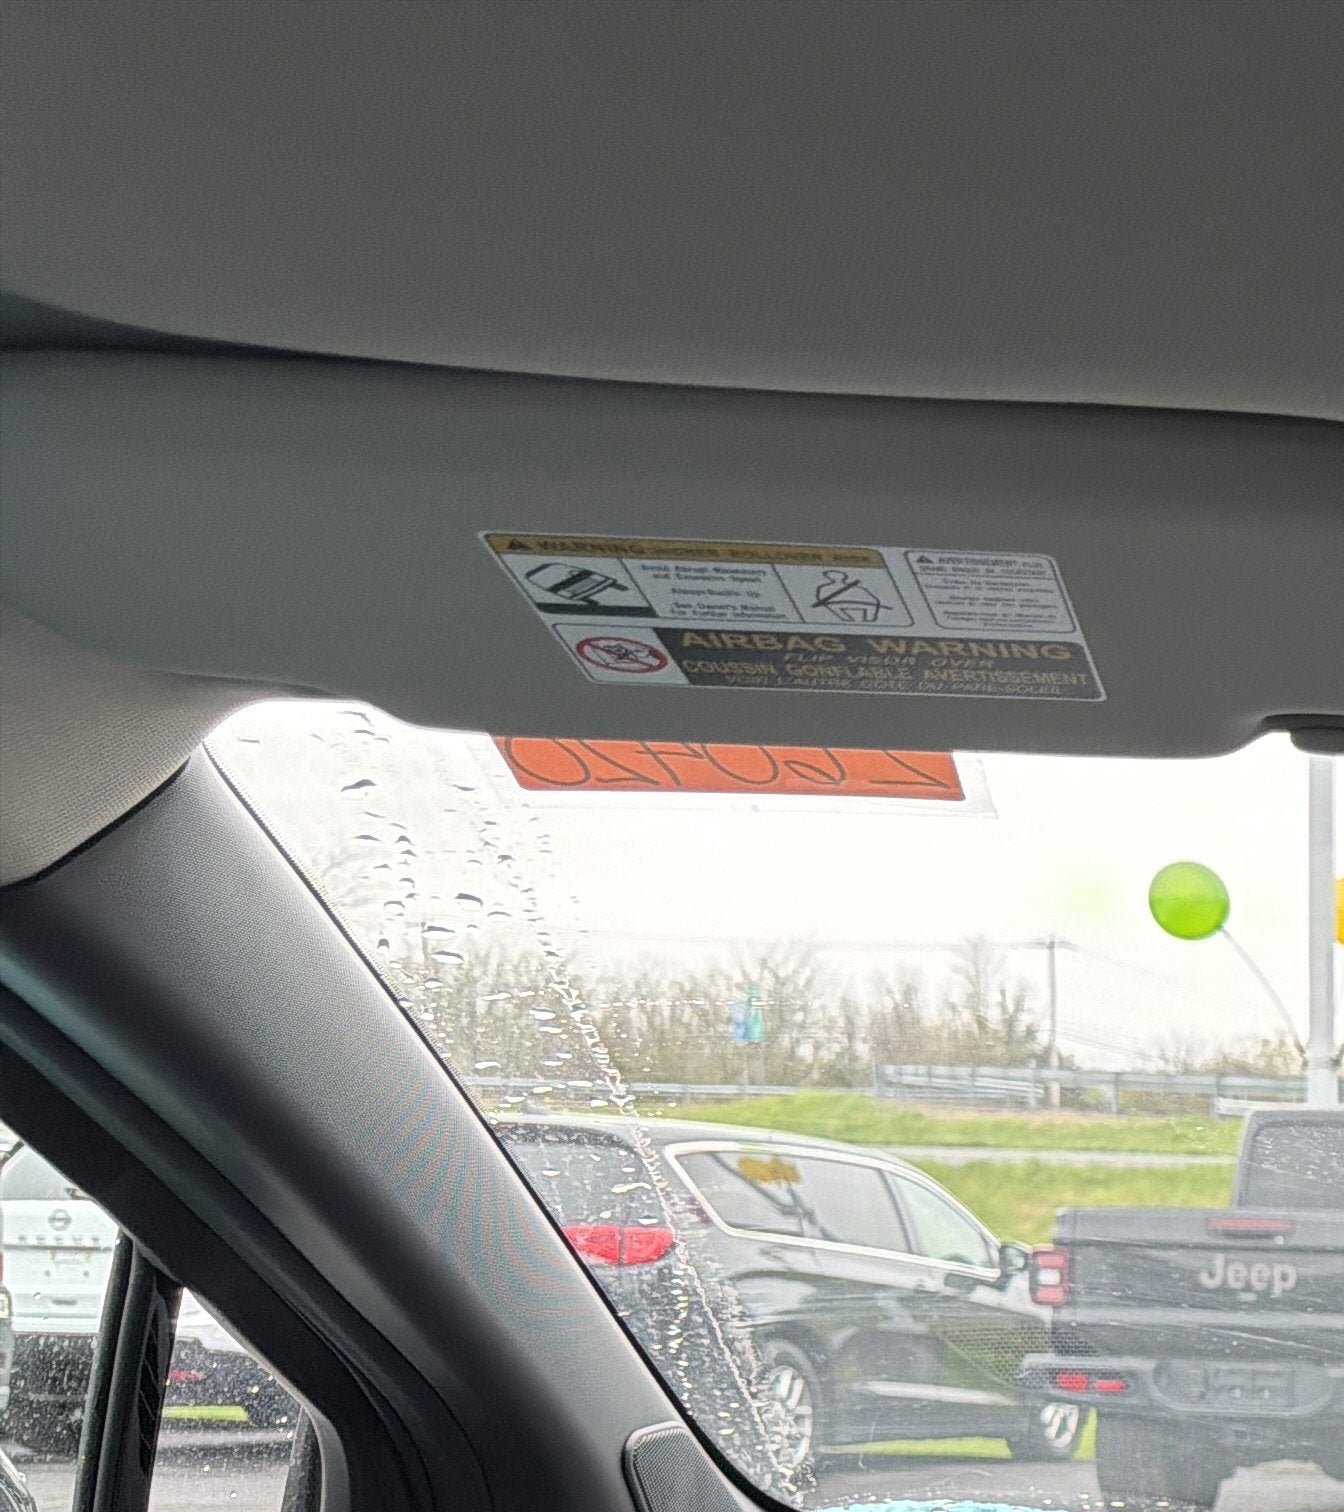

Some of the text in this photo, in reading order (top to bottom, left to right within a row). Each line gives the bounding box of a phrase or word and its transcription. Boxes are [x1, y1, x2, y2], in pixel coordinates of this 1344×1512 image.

[681, 631, 1074, 660] AIRBAG WARNING
[682, 659, 776, 676] COUSSIN
[787, 662, 912, 681] GONFLABLE
[922, 667, 1089, 686] AVERTISSEMENT
[1200, 1253, 1297, 1298] Jeep
